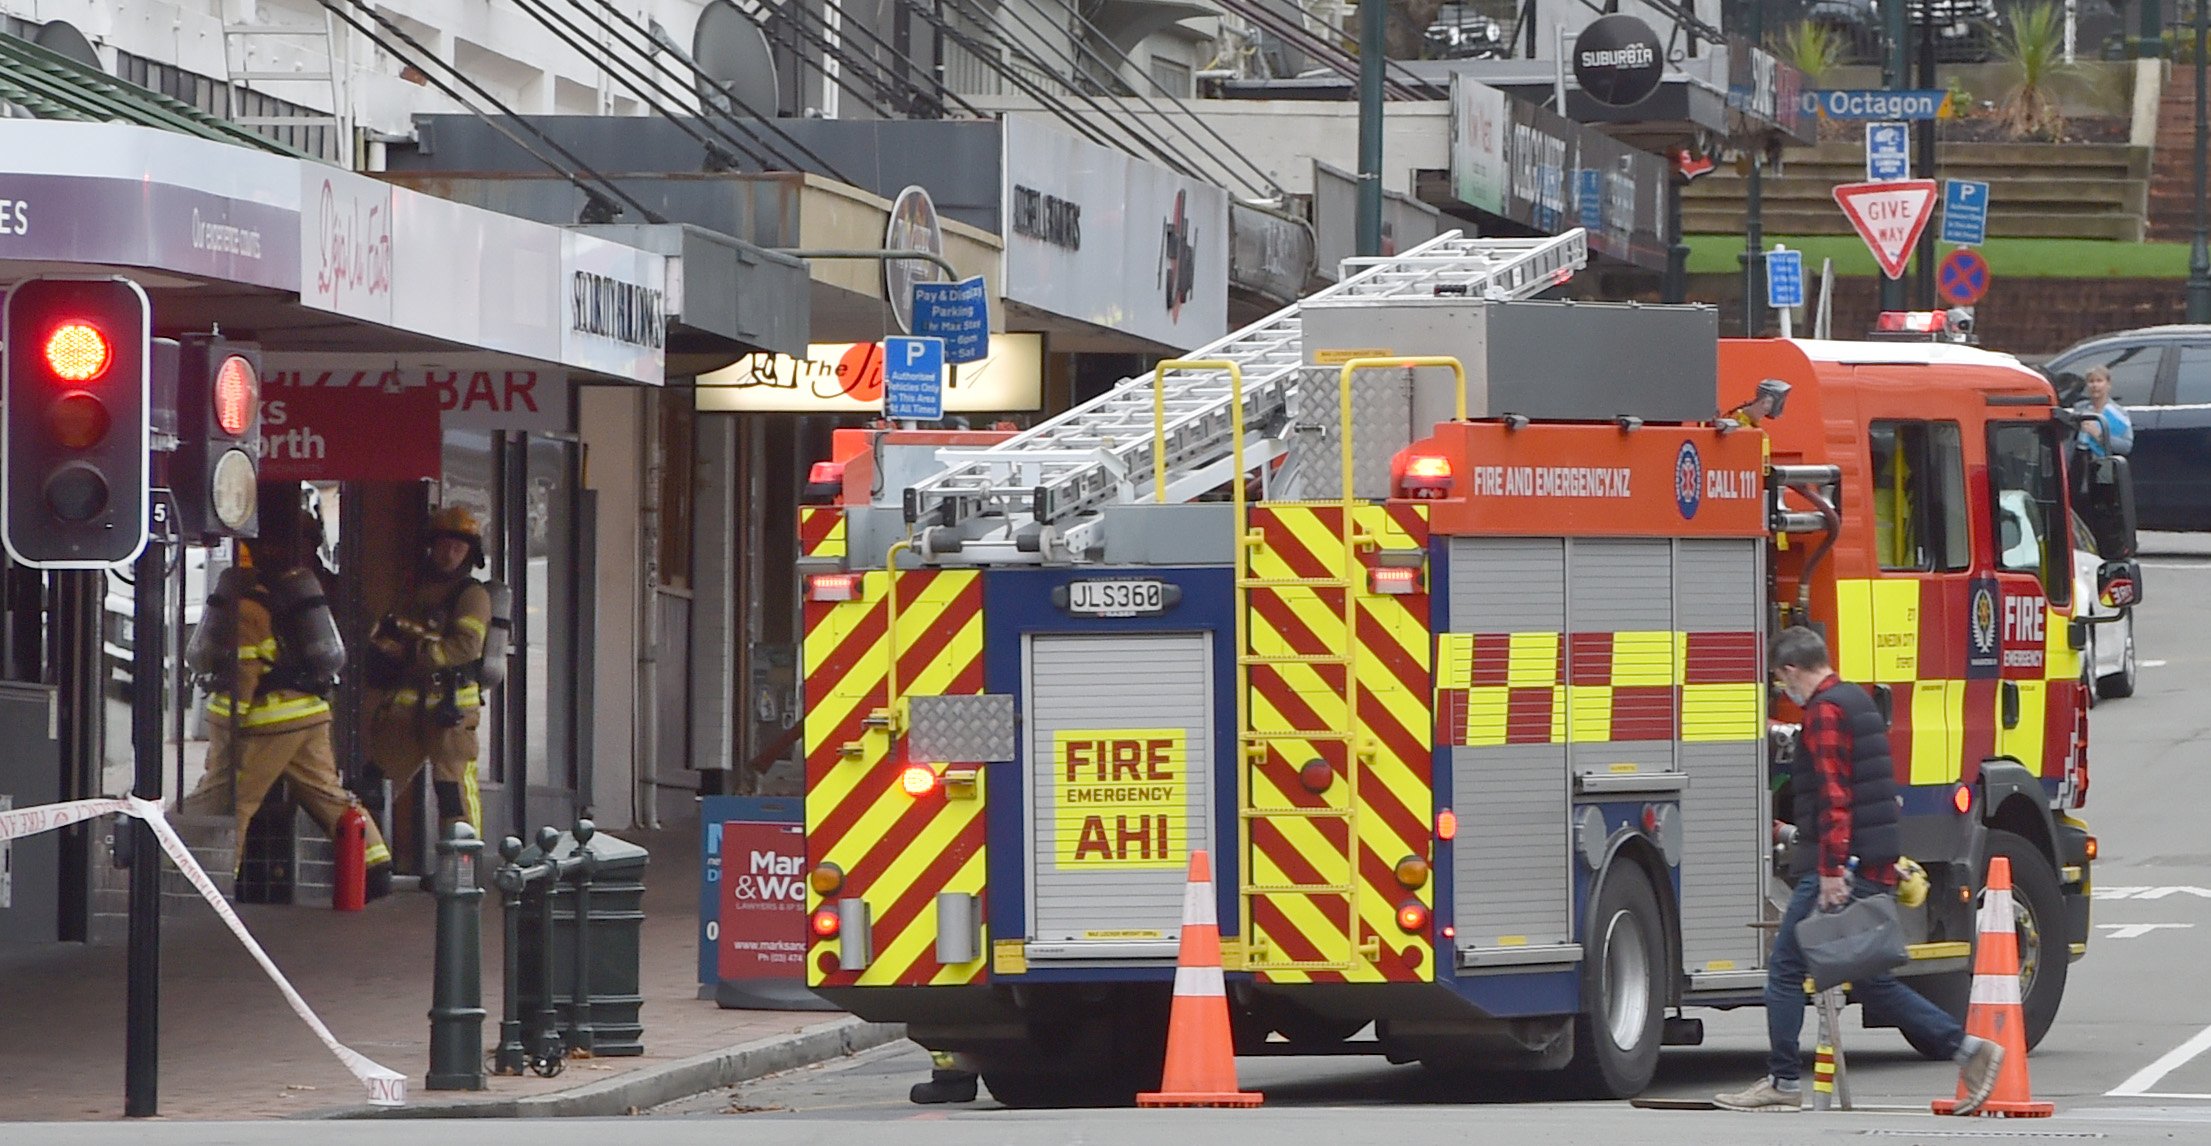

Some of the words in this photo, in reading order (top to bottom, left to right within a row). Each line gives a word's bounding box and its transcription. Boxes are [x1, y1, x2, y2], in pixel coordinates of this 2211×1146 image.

[1581, 43, 1654, 67] SUBURBIA
[1829, 91, 1934, 117] Octagon
[1960, 184, 1976, 201] P
[0, 199, 29, 235] ES
[1868, 200, 1911, 221] GIVE
[1879, 228, 1905, 242] WAY
[916, 289, 938, 303] Pay
[938, 289, 948, 301] &
[932, 305, 974, 318] Parking
[906, 342, 926, 367] P
[959, 347, 976, 358] Sat
[805, 359, 848, 378] The
[426, 371, 539, 413] BAR
[1474, 466, 1503, 496] FIRE
[1505, 467, 1533, 497] AND
[1535, 467, 1631, 498] EMERGENCY.NZ
[1707, 469, 1738, 499] CALL
[1739, 471, 1757, 499] 111
[153, 503, 166, 522] 5
[1073, 585, 1160, 608] JLS360
[2004, 595, 2045, 642] FIRE
[2003, 650, 2043, 667] EMERGENCY
[1066, 739, 1174, 783] FIRE
[1066, 786, 1174, 803] EMERGENCY
[1074, 814, 1169, 861] AHI
[750, 850, 806, 876] Mar
